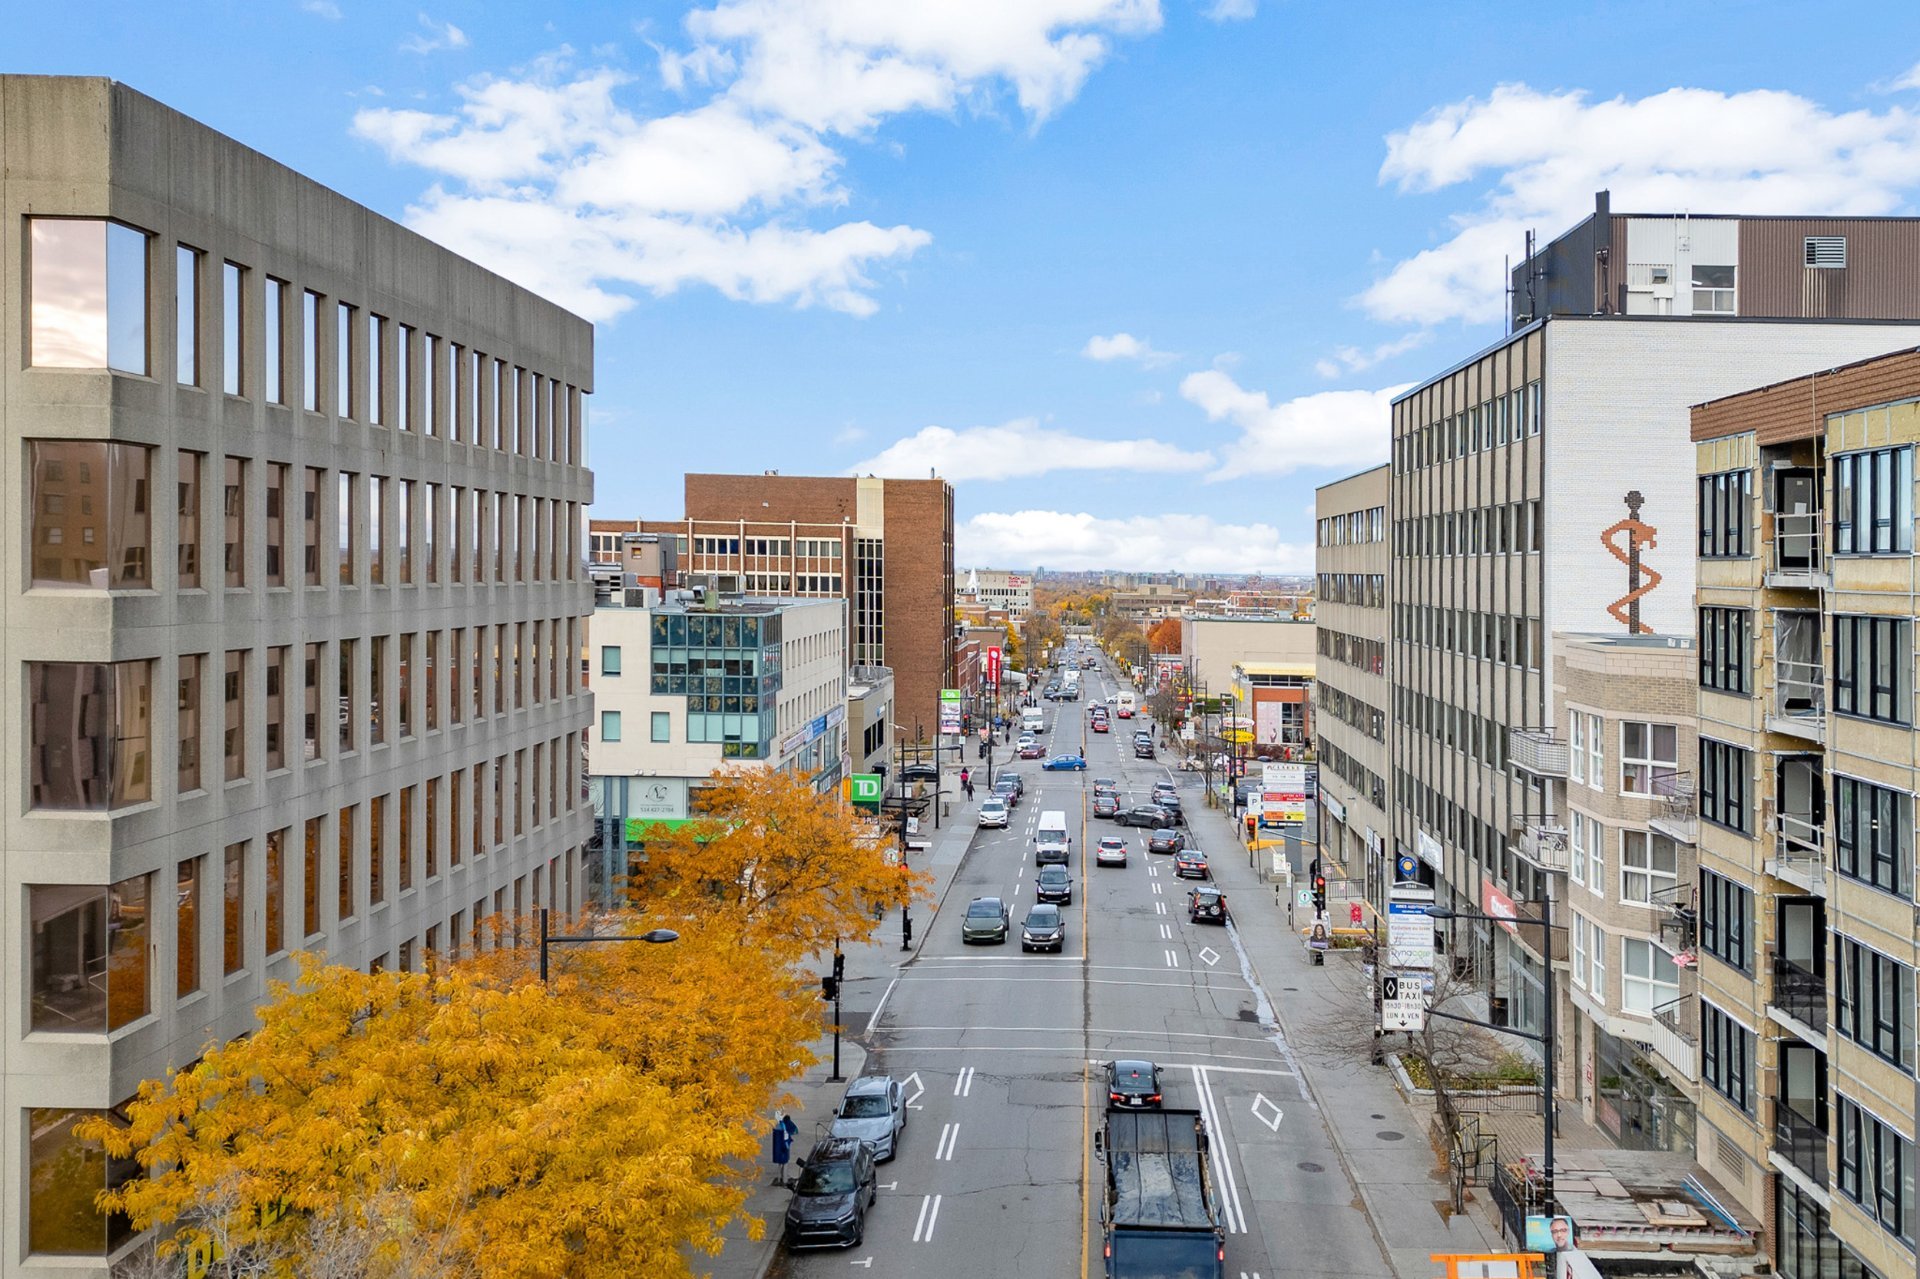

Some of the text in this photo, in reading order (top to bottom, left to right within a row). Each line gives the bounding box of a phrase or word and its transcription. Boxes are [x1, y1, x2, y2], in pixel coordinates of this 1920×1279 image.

[855, 780, 878, 796] TD
[1399, 981, 1420, 990] BUS
[1399, 992, 1420, 1000] TAXI
